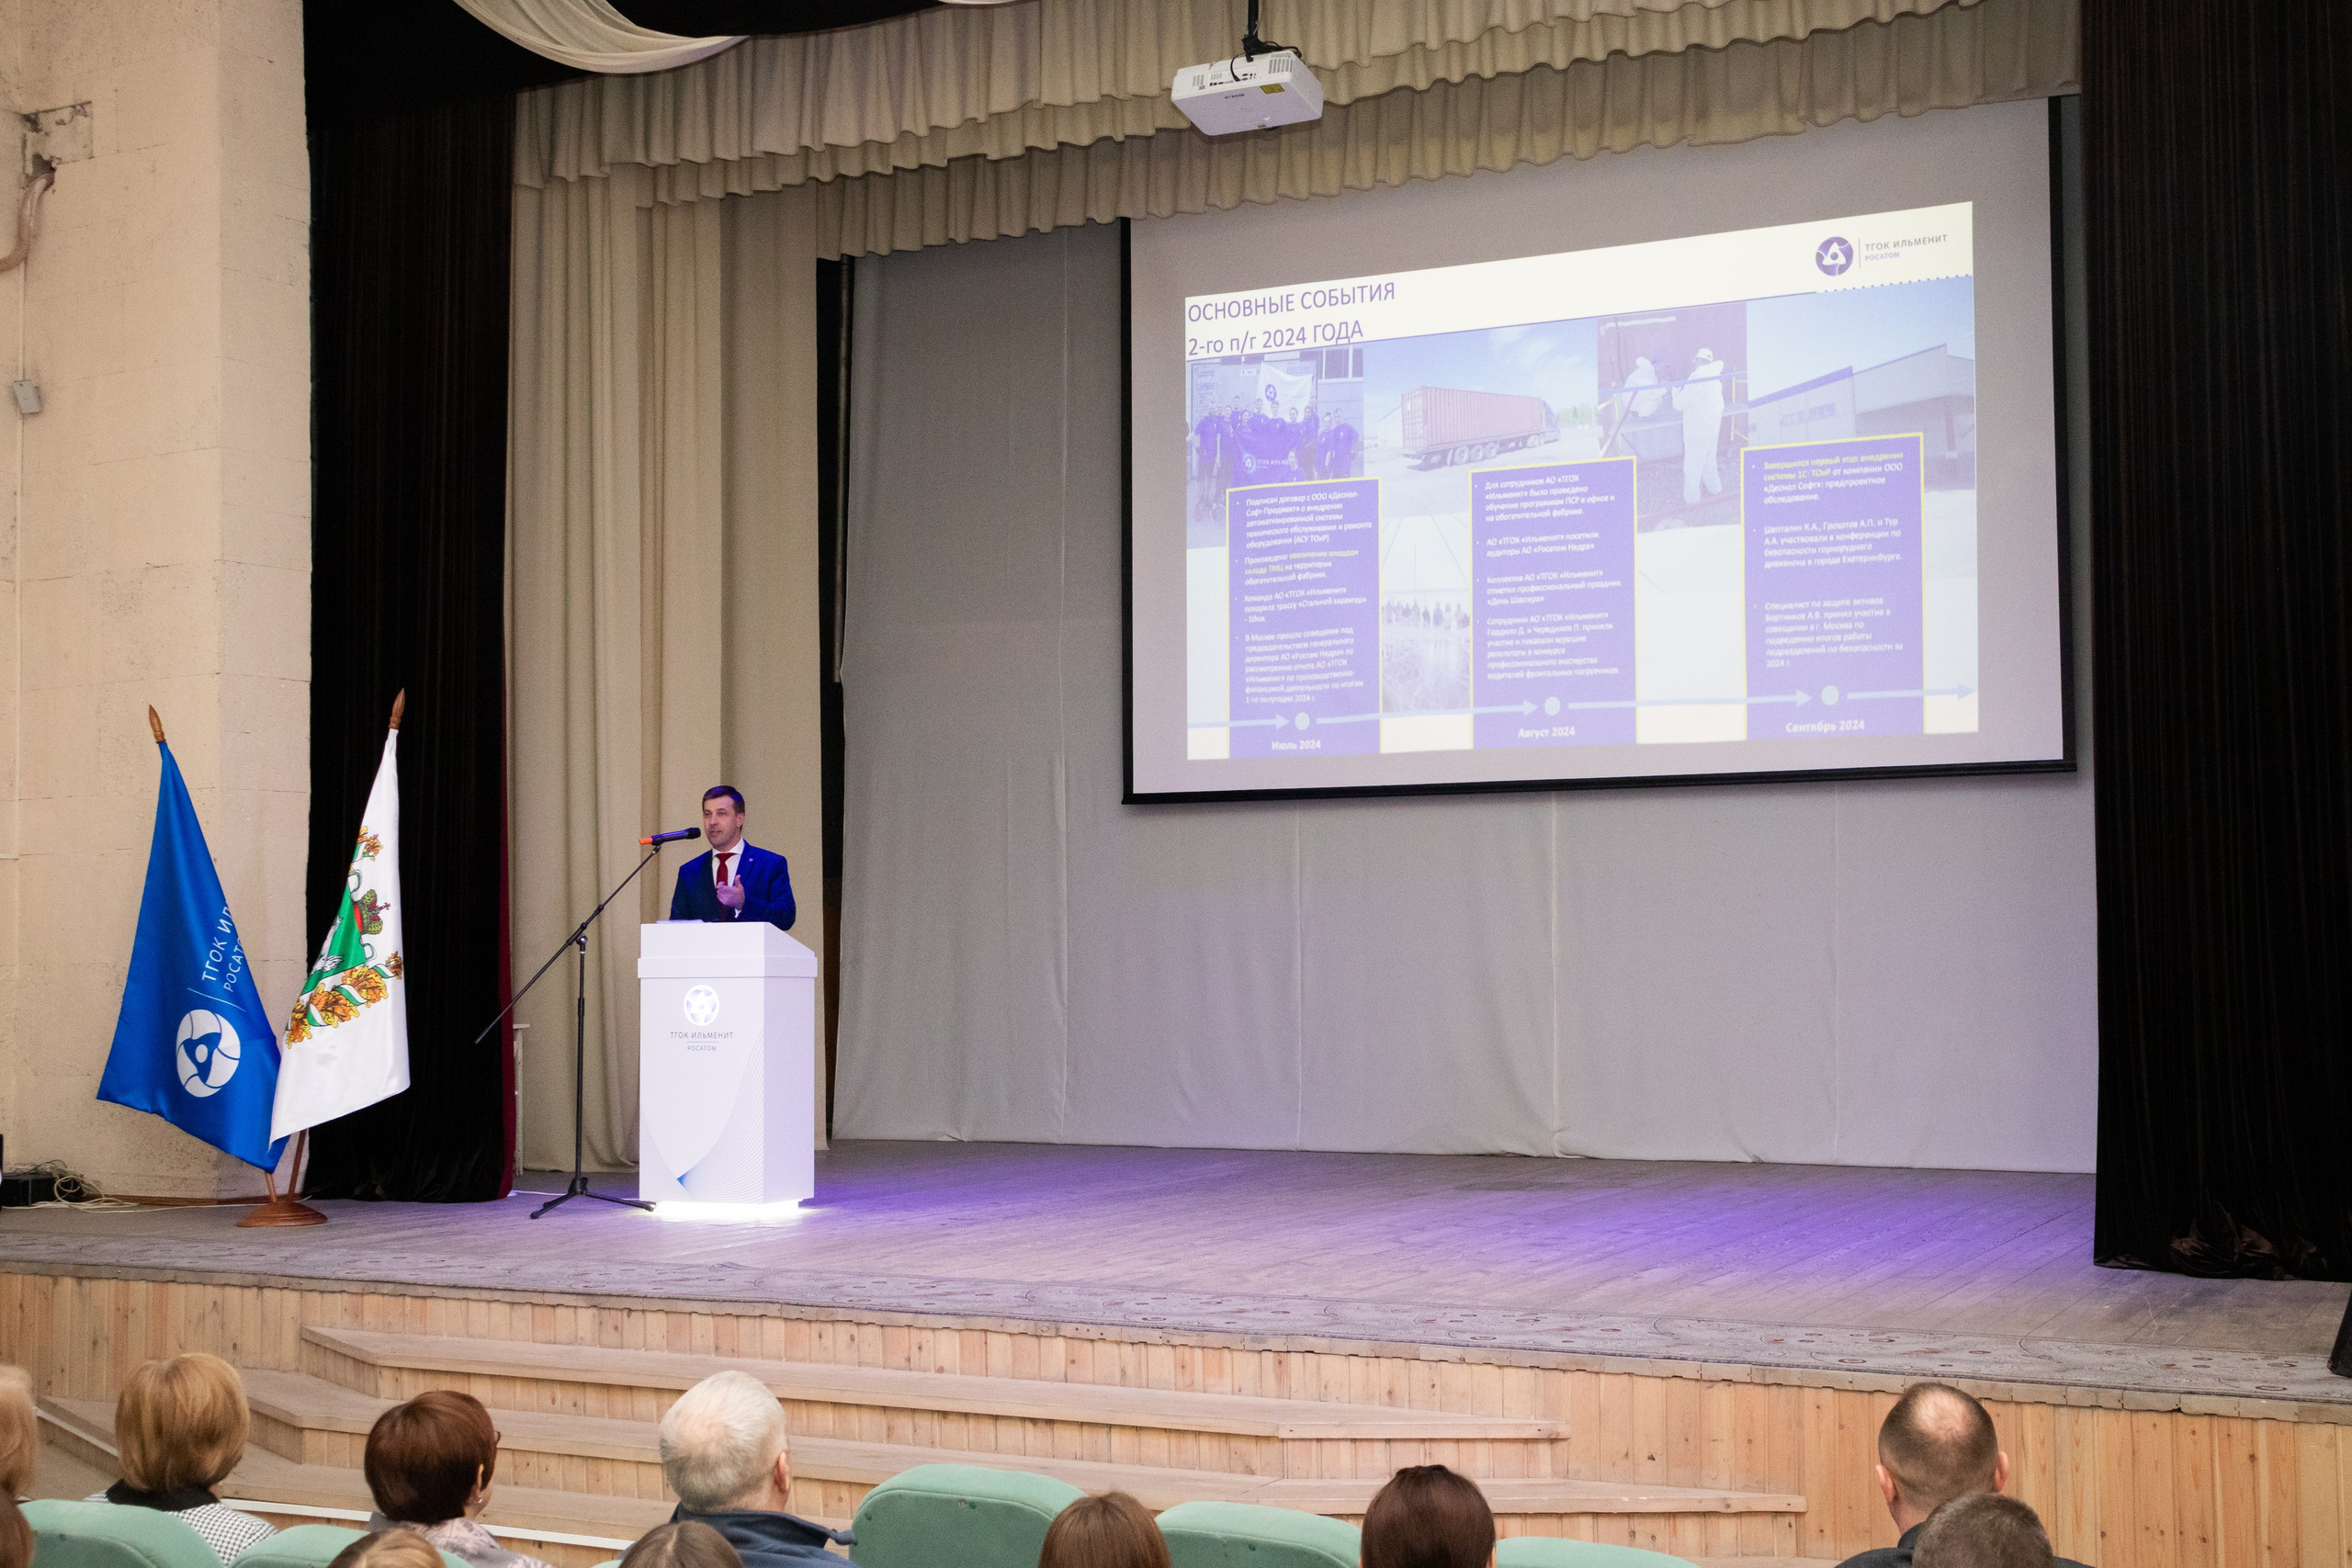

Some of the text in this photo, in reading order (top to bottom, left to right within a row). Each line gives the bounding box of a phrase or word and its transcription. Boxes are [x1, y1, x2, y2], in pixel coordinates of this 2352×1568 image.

[1865, 234, 1948, 252] ТГОК ИЛЬМЕНИТ
[1864, 252, 1901, 261] РОСАТОМ
[1188, 282, 1395, 322] ОСНОВНЫЕ СОБЫТИЯ
[1188, 320, 1363, 356] 2-го п/г 2024 ГОДА
[1518, 727, 1576, 739] Август 2024
[1786, 720, 1865, 733] Сентябрь 2024
[1272, 740, 1321, 750] Июль 2024
[202, 937, 228, 981] ТГОК
